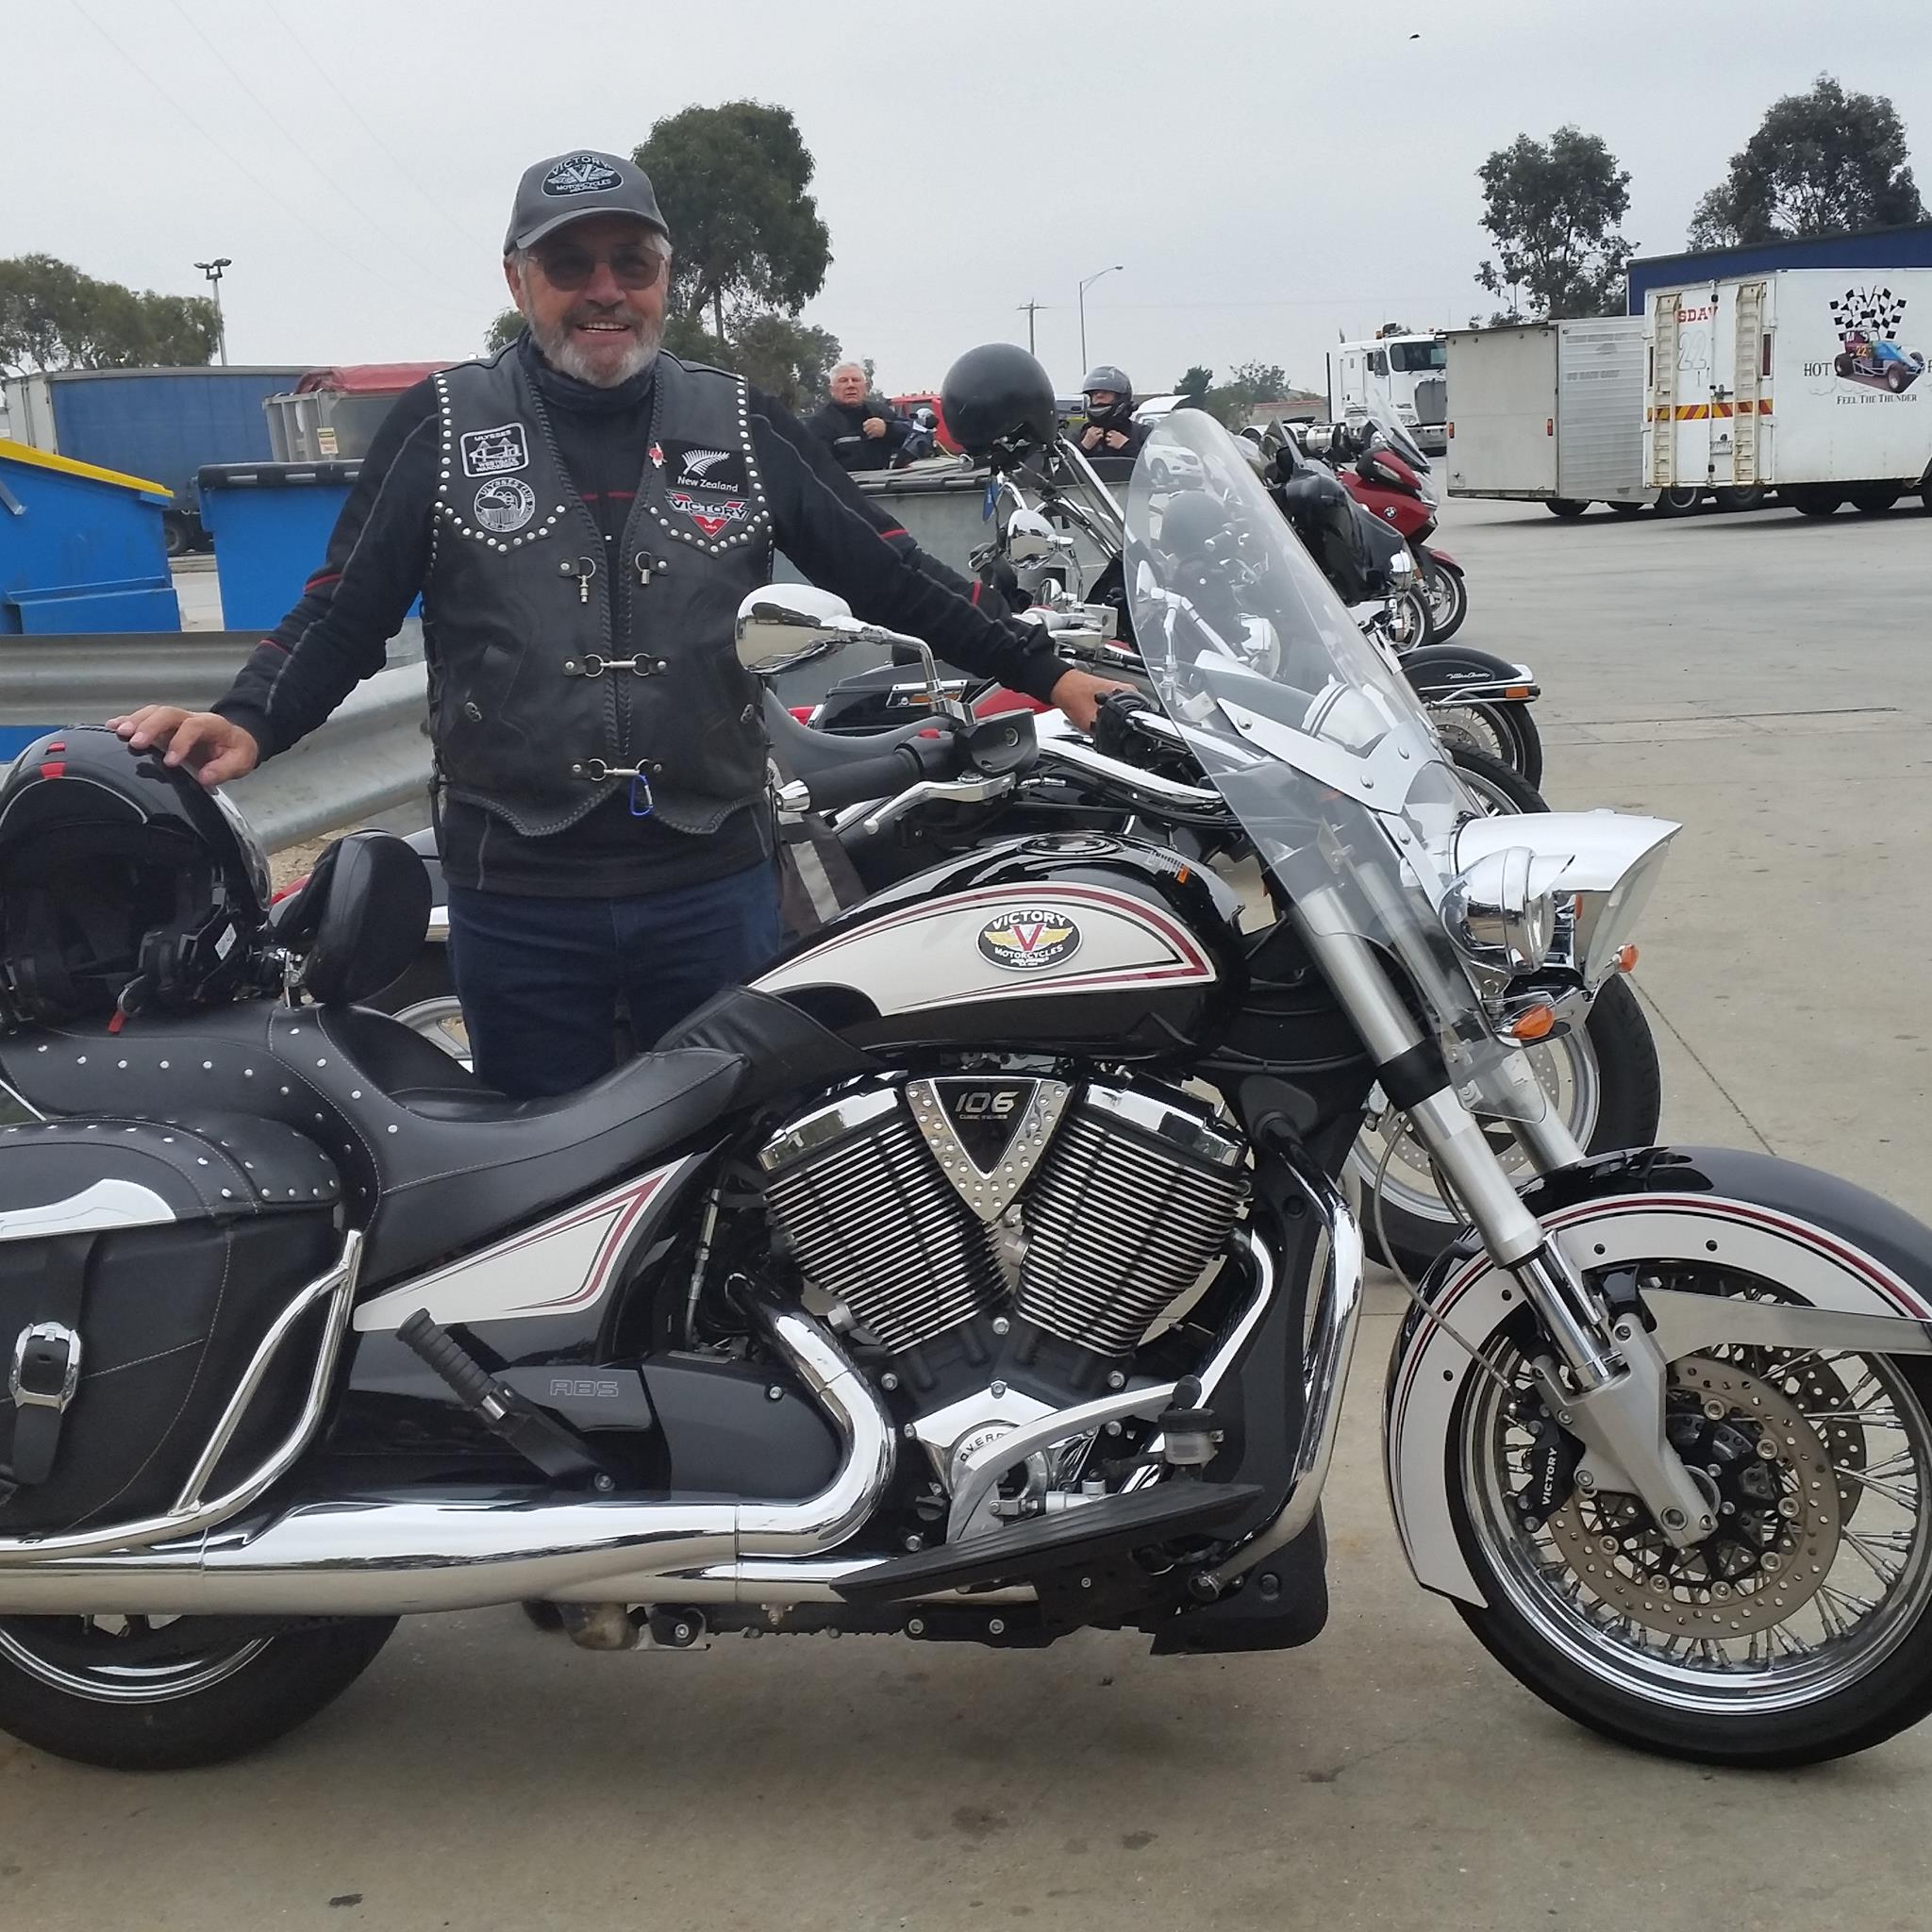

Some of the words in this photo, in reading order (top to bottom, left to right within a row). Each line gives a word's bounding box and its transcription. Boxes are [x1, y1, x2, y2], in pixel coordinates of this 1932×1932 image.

[552, 156, 614, 175] VICTORY
[1804, 362, 1833, 377] HOT
[1837, 395, 1857, 405] FEEL
[1860, 394, 1875, 404] THE
[1878, 393, 1918, 403] THUNDER
[677, 475, 698, 487] New
[700, 478, 739, 492] Zealand
[672, 500, 749, 520] VICTORY
[992, 909, 1066, 930] VICTORY
[993, 943, 1064, 958] MOTORCYCLES
[955, 1091, 1020, 1112] 106
[550, 1379, 619, 1397] ABS
[1541, 1446, 1557, 1506] VICTORY
